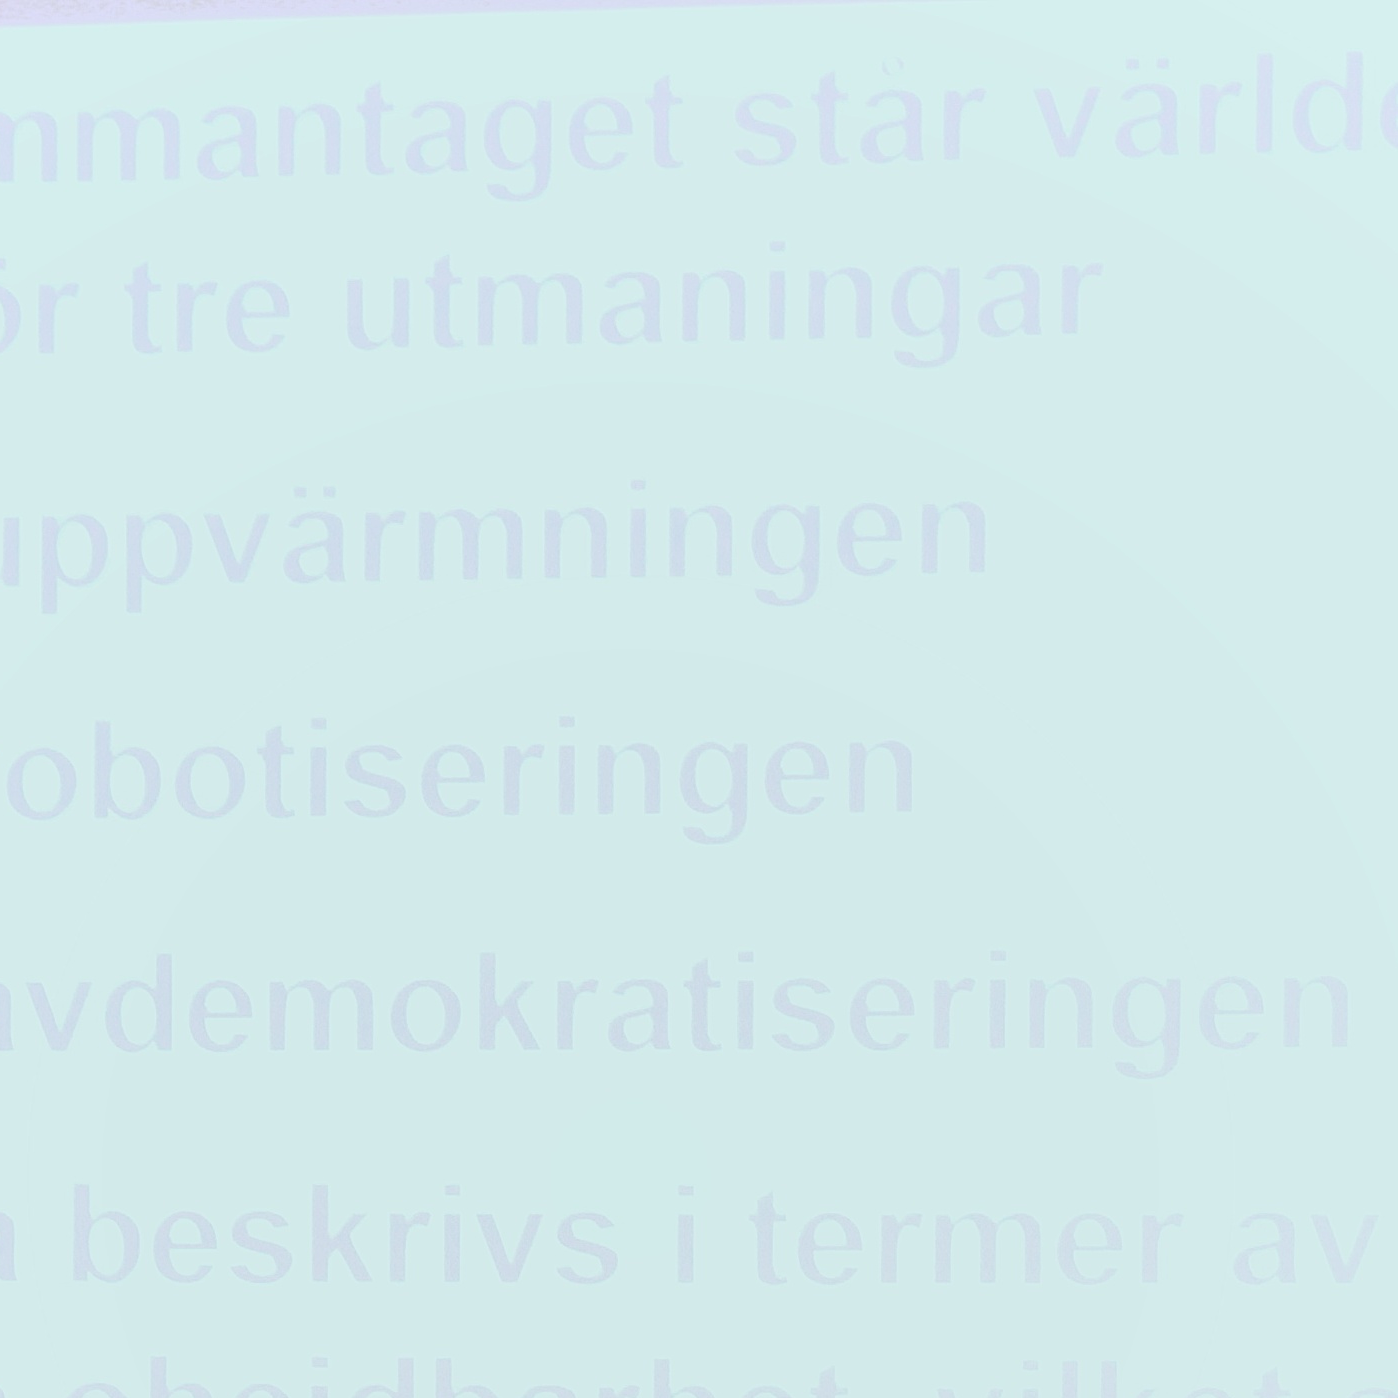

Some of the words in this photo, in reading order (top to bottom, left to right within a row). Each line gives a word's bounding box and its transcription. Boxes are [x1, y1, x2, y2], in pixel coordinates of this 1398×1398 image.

[735, 60, 986, 166] står
[1034, 51, 1398, 158] värld
[124, 262, 290, 354] tre
[347, 241, 1103, 368] utmaningar
[73, 1184, 618, 1284] beskrivs
[678, 1185, 694, 1283] i
[749, 1193, 1183, 1285] termer
[1234, 1213, 1376, 1285] av
